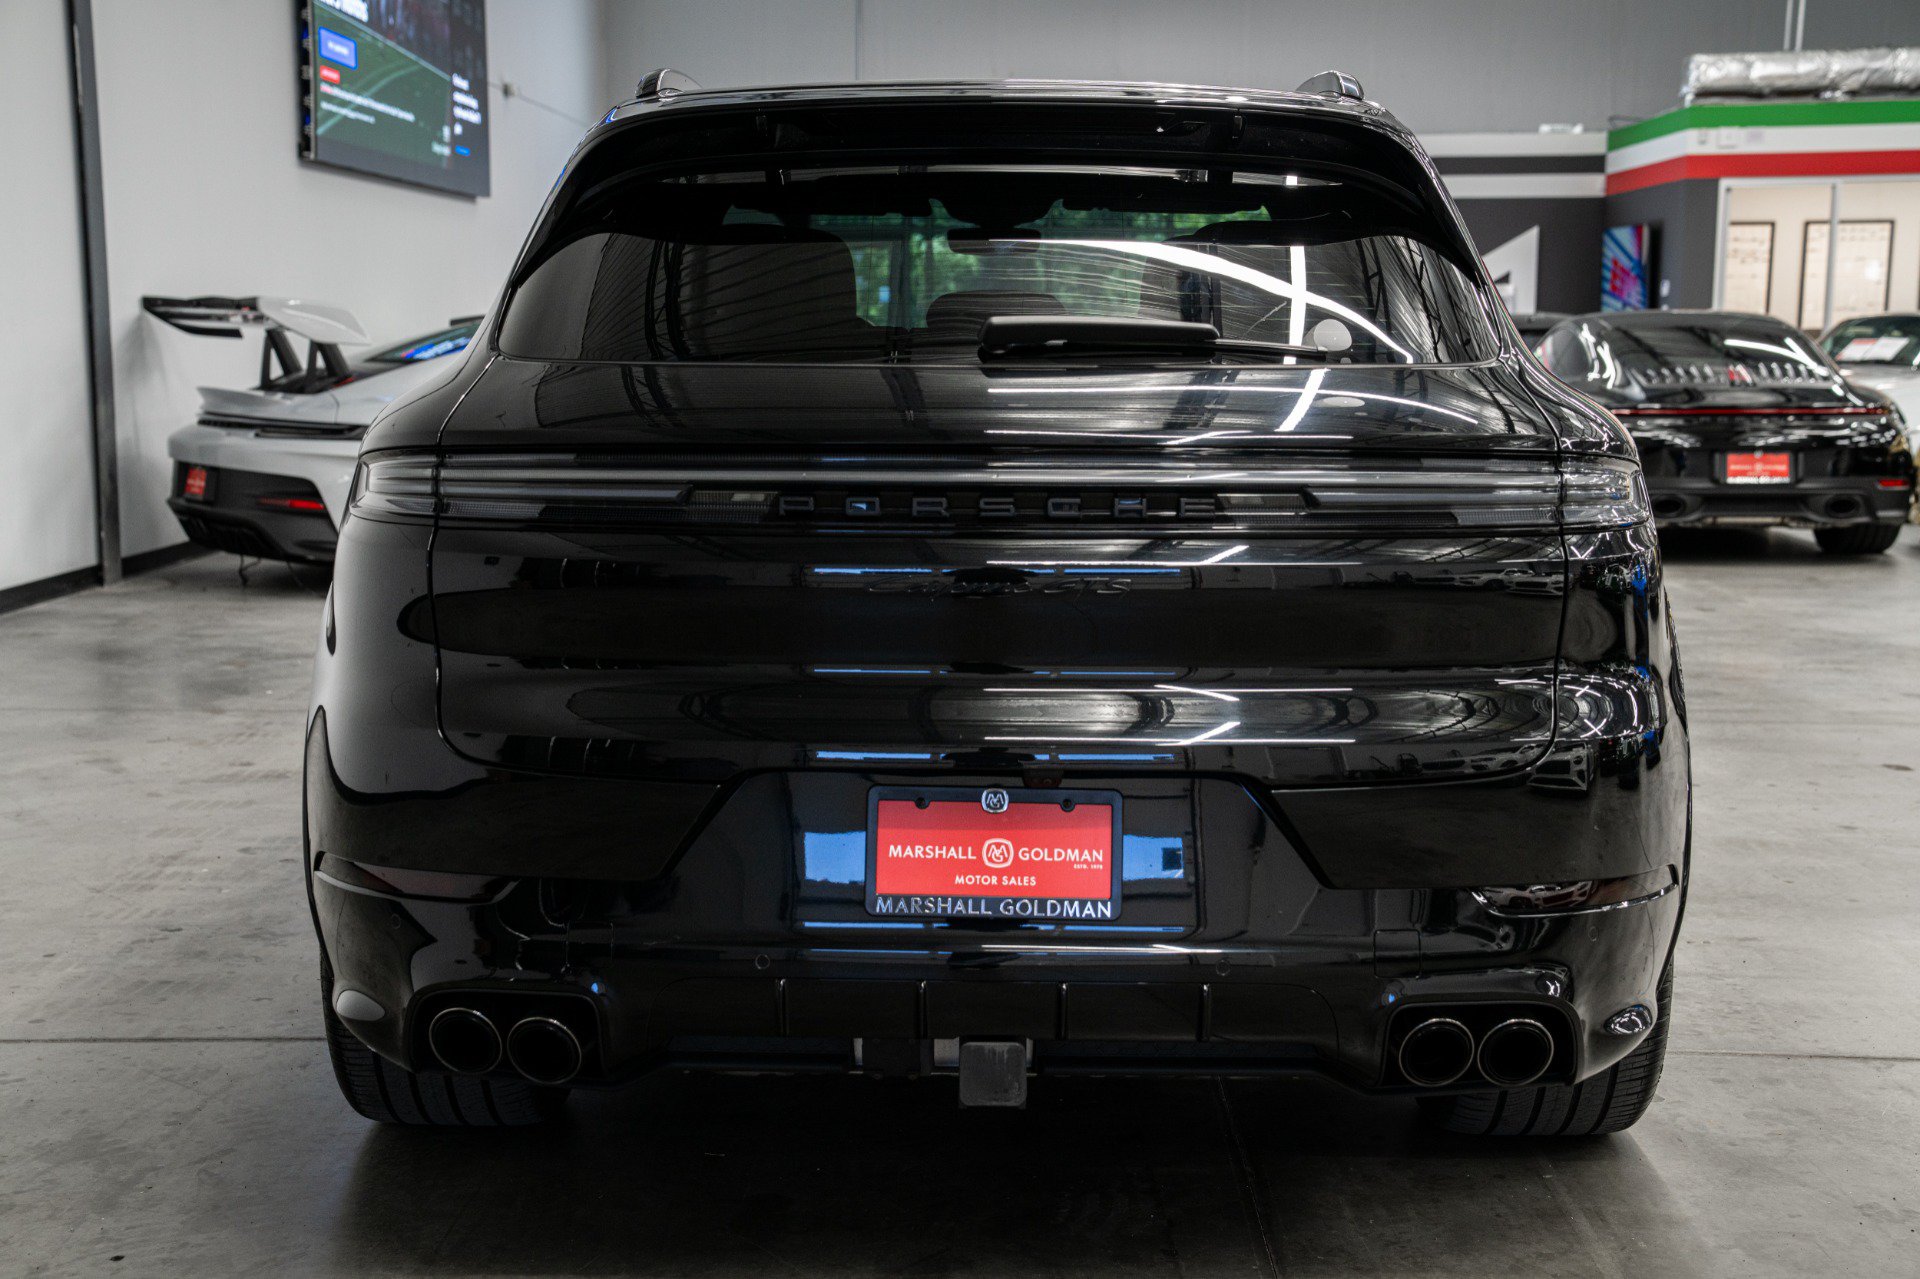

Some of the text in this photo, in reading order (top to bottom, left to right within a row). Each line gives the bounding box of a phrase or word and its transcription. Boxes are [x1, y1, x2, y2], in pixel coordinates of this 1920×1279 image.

[777, 496, 1217, 519] PORSCHE
[1044, 577, 1132, 597] GTS
[888, 844, 976, 860] MARSHALL
[1018, 847, 1103, 862] GOLDMAN
[954, 875, 1037, 887] MOTOR SALES
[876, 896, 1112, 919] MARSHALL GOLDMAN
